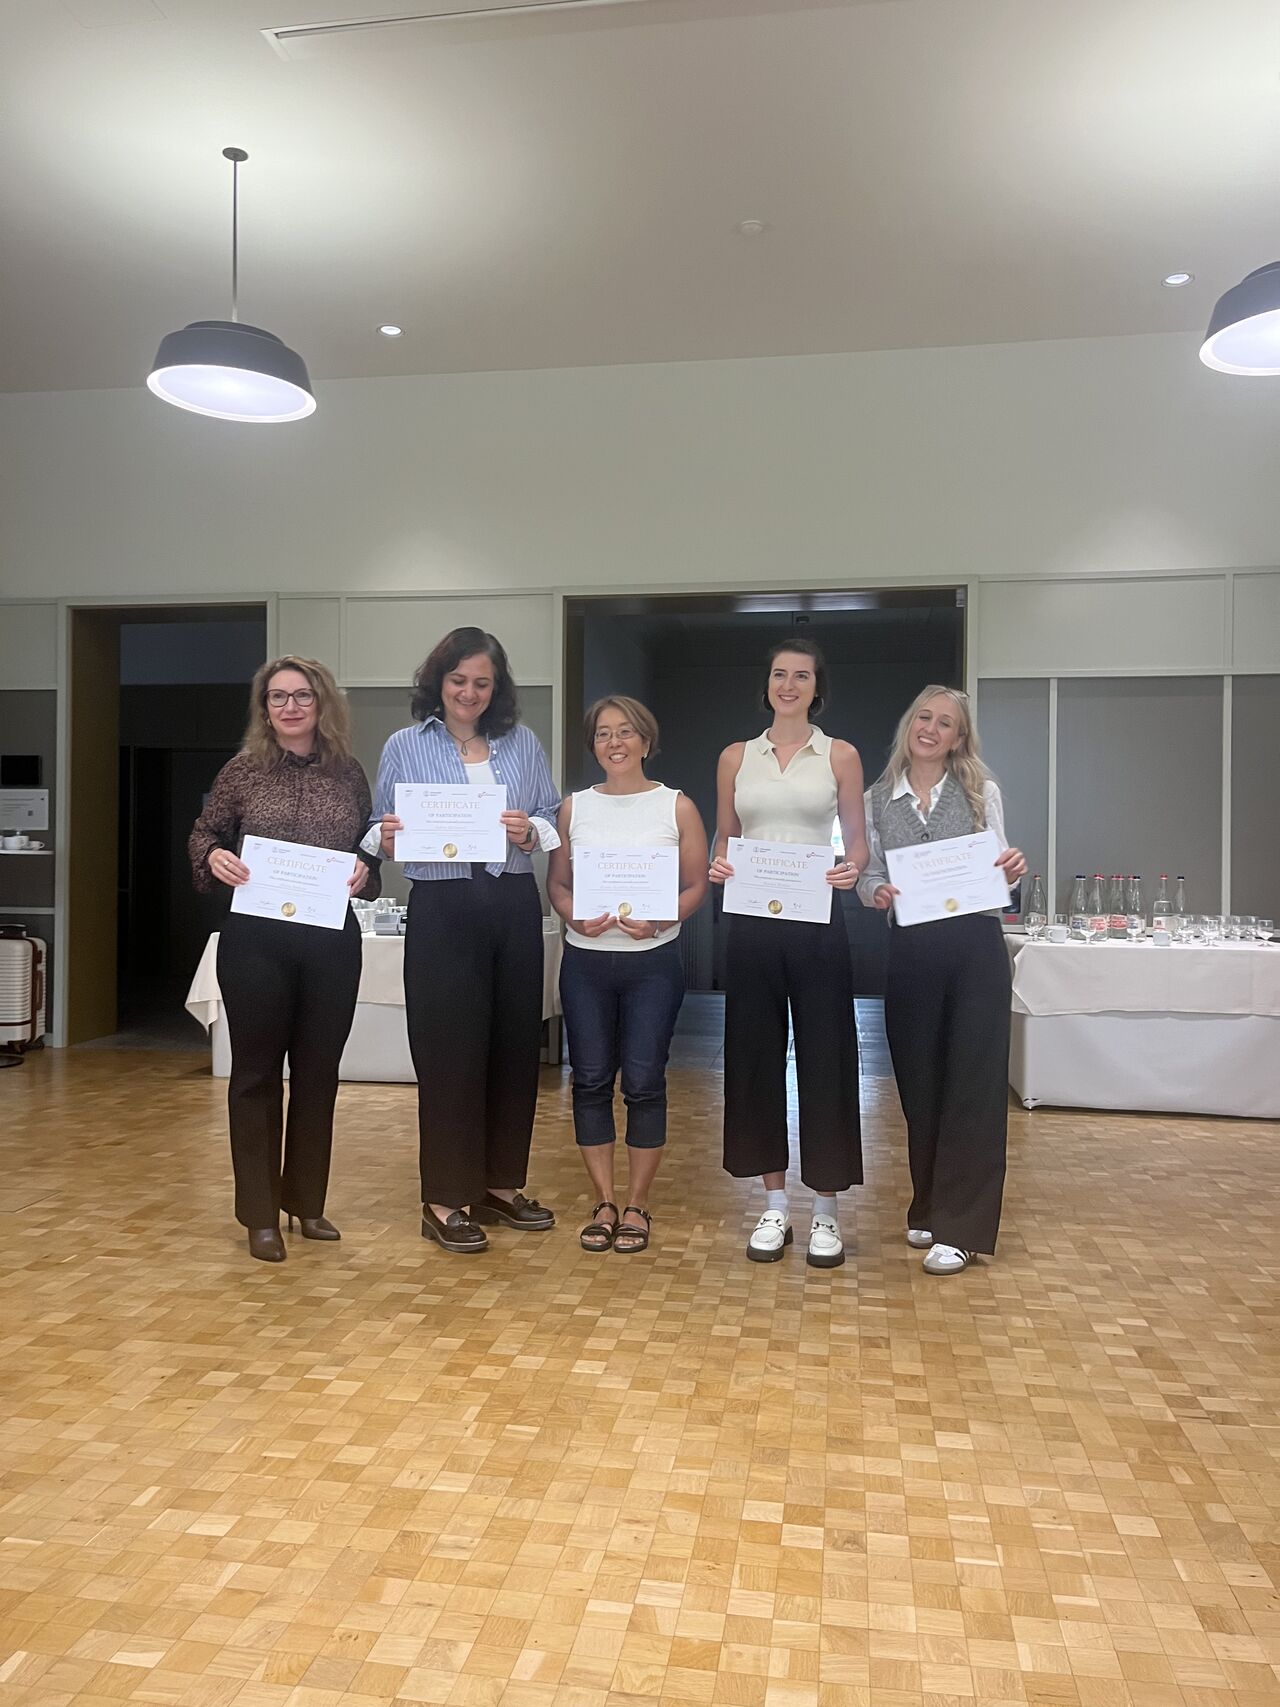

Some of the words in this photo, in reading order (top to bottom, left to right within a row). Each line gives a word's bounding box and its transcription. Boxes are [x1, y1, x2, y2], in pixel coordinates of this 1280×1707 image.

[420, 801, 480, 810] CERTIFICATE
[267, 855, 328, 873] CERTIFICATE
[598, 862, 655, 870] CERTIFICATE
[751, 856, 808, 869] CERTIFICATE
